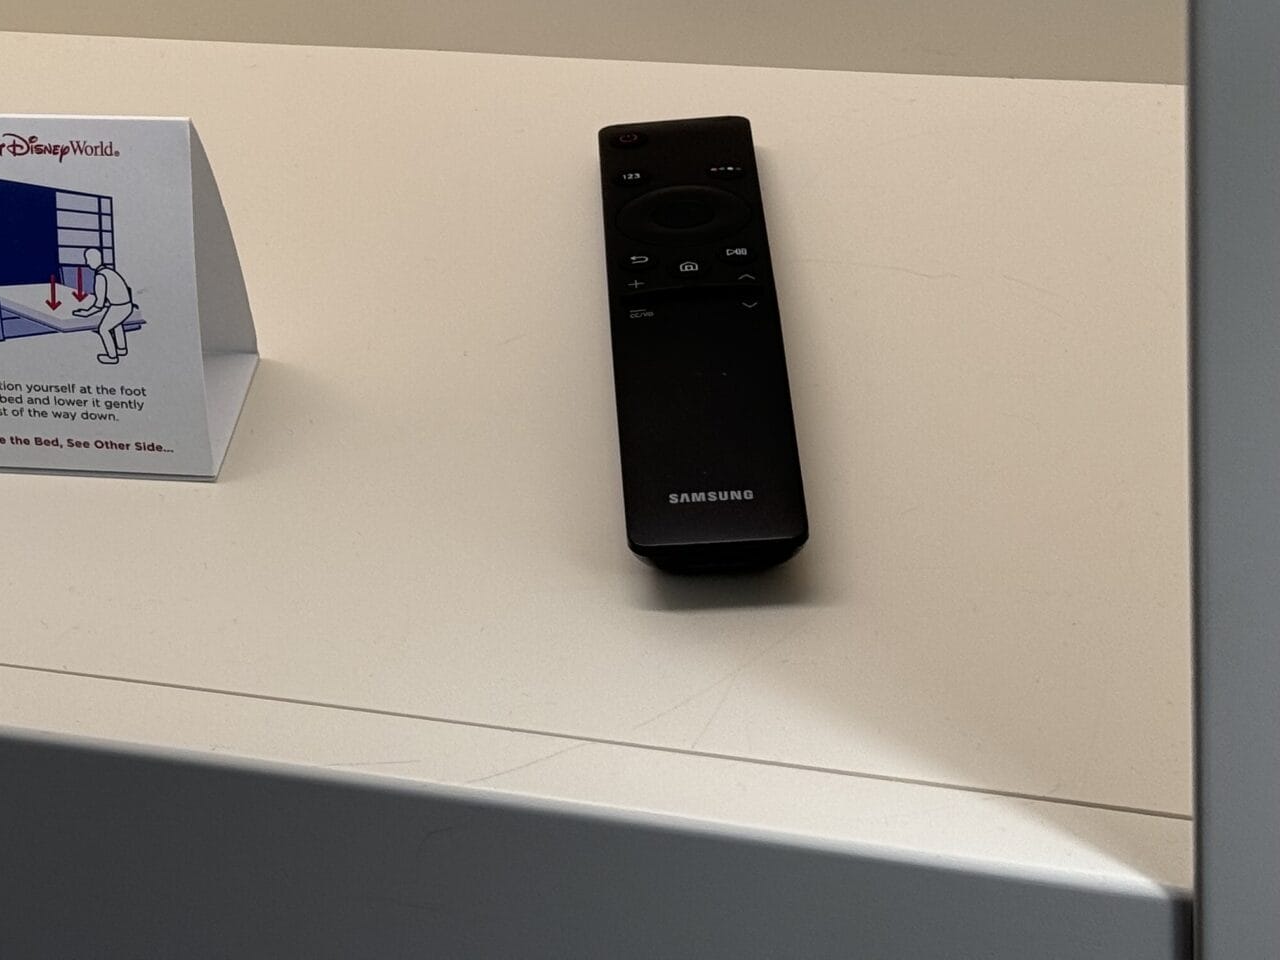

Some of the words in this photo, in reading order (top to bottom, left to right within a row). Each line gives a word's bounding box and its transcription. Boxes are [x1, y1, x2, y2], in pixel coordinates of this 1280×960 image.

[26, 383, 75, 394] yourself
[80, 385, 92, 394] at
[96, 385, 116, 395] the
[120, 386, 147, 397] foot
[0, 394, 22, 404] bed
[27, 395, 50, 405] and
[54, 396, 88, 407] lower
[92, 398, 101, 407] it
[105, 399, 144, 411] gently
[12, 407, 25, 416] of
[28, 408, 48, 418] the
[52, 411, 76, 421] way
[81, 410, 119, 421] down.
[10, 436, 30, 446] the
[34, 437, 63, 448] Bed,
[67, 438, 90, 449] See
[94, 440, 131, 451] Other
[669, 490, 754, 504] SAMSUNG
